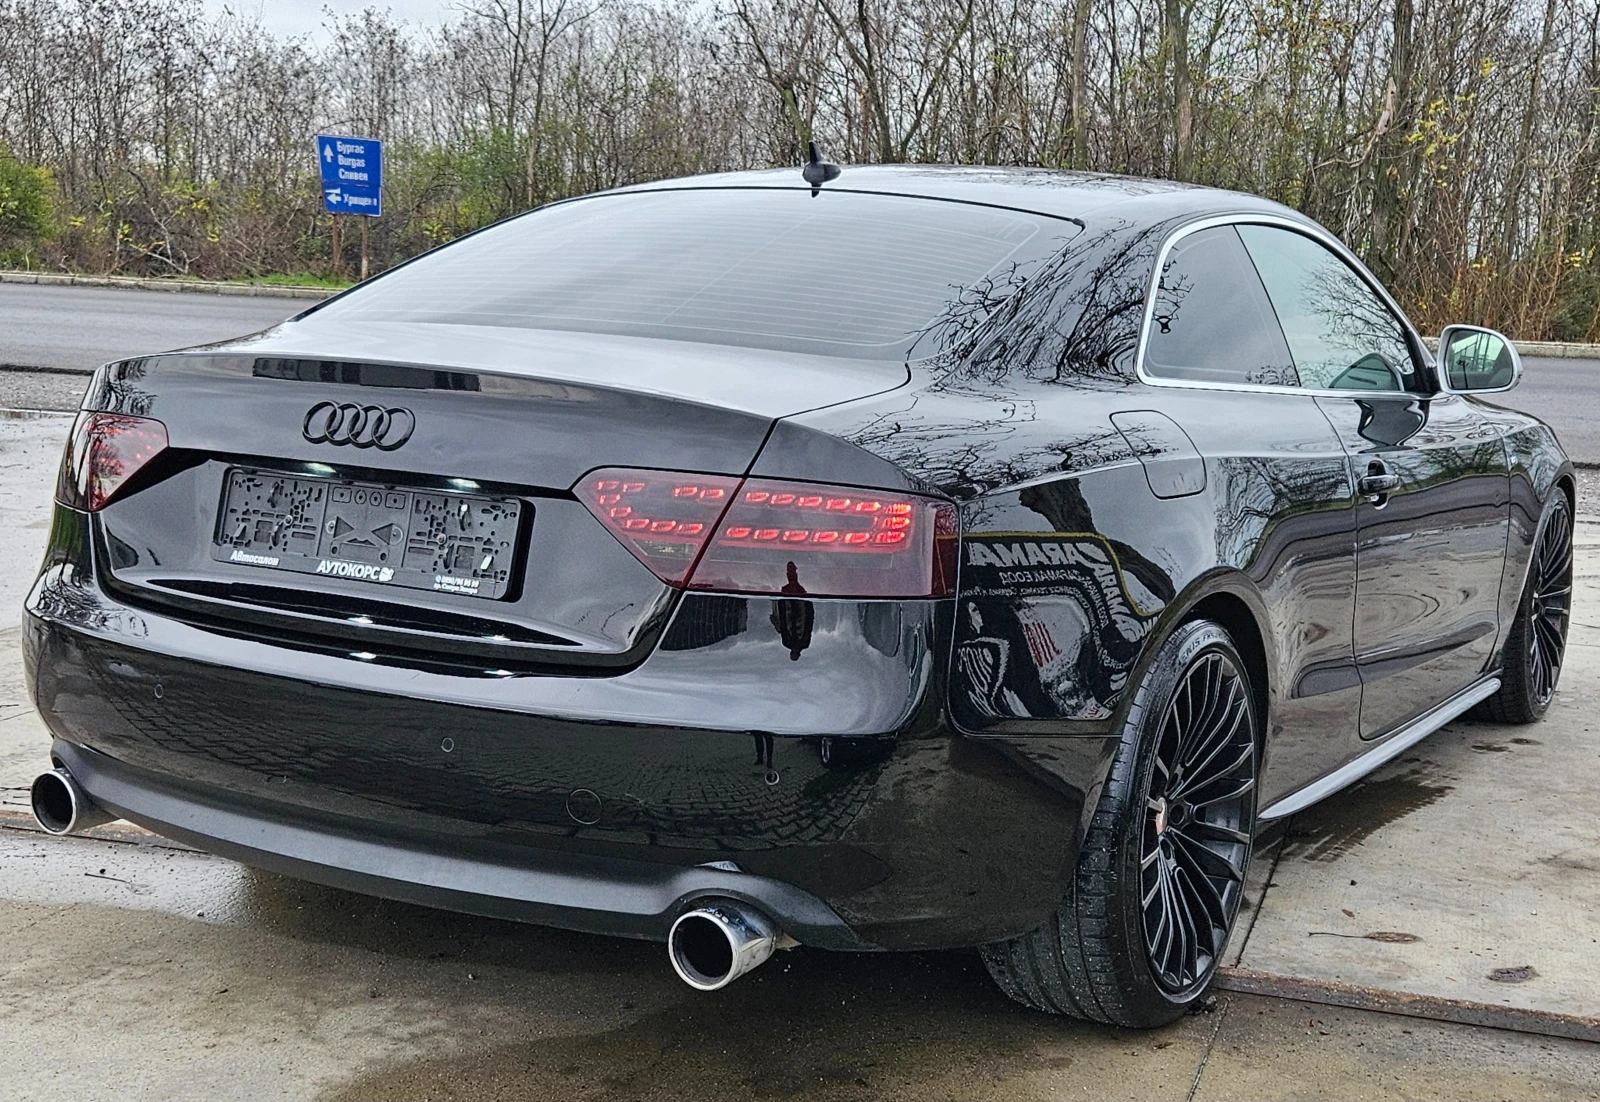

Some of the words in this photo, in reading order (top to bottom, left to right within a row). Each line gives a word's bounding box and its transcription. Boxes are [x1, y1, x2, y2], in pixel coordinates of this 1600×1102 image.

[336, 141, 364, 154] Бургас
[337, 155, 365, 168] Burgas
[338, 168, 368, 181] Сливен
[316, 560, 380, 580] АУТОКОРС
